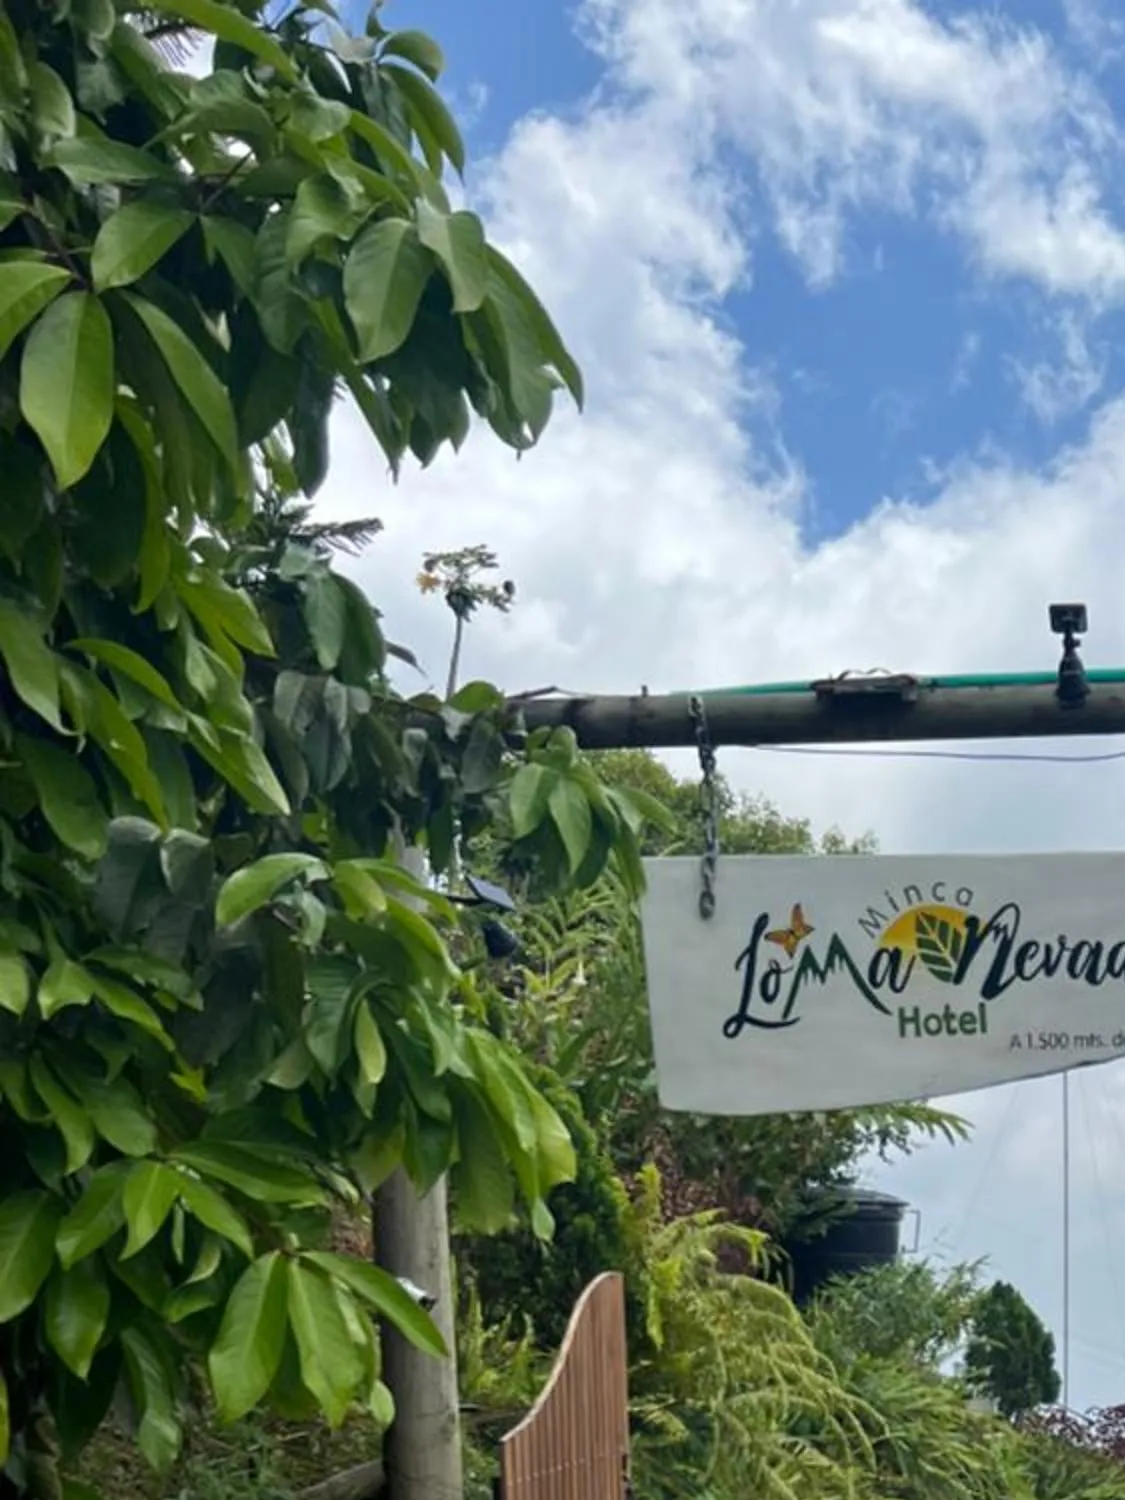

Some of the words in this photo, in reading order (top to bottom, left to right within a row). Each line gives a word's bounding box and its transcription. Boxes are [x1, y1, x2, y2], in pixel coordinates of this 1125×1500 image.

[858, 881, 975, 938] Minca
[899, 1002, 988, 1038] Hotel
[1010, 1033, 1022, 1048] A
[1026, 1031, 1069, 1049] 1.500
[1072, 1030, 1105, 1047] mts.
